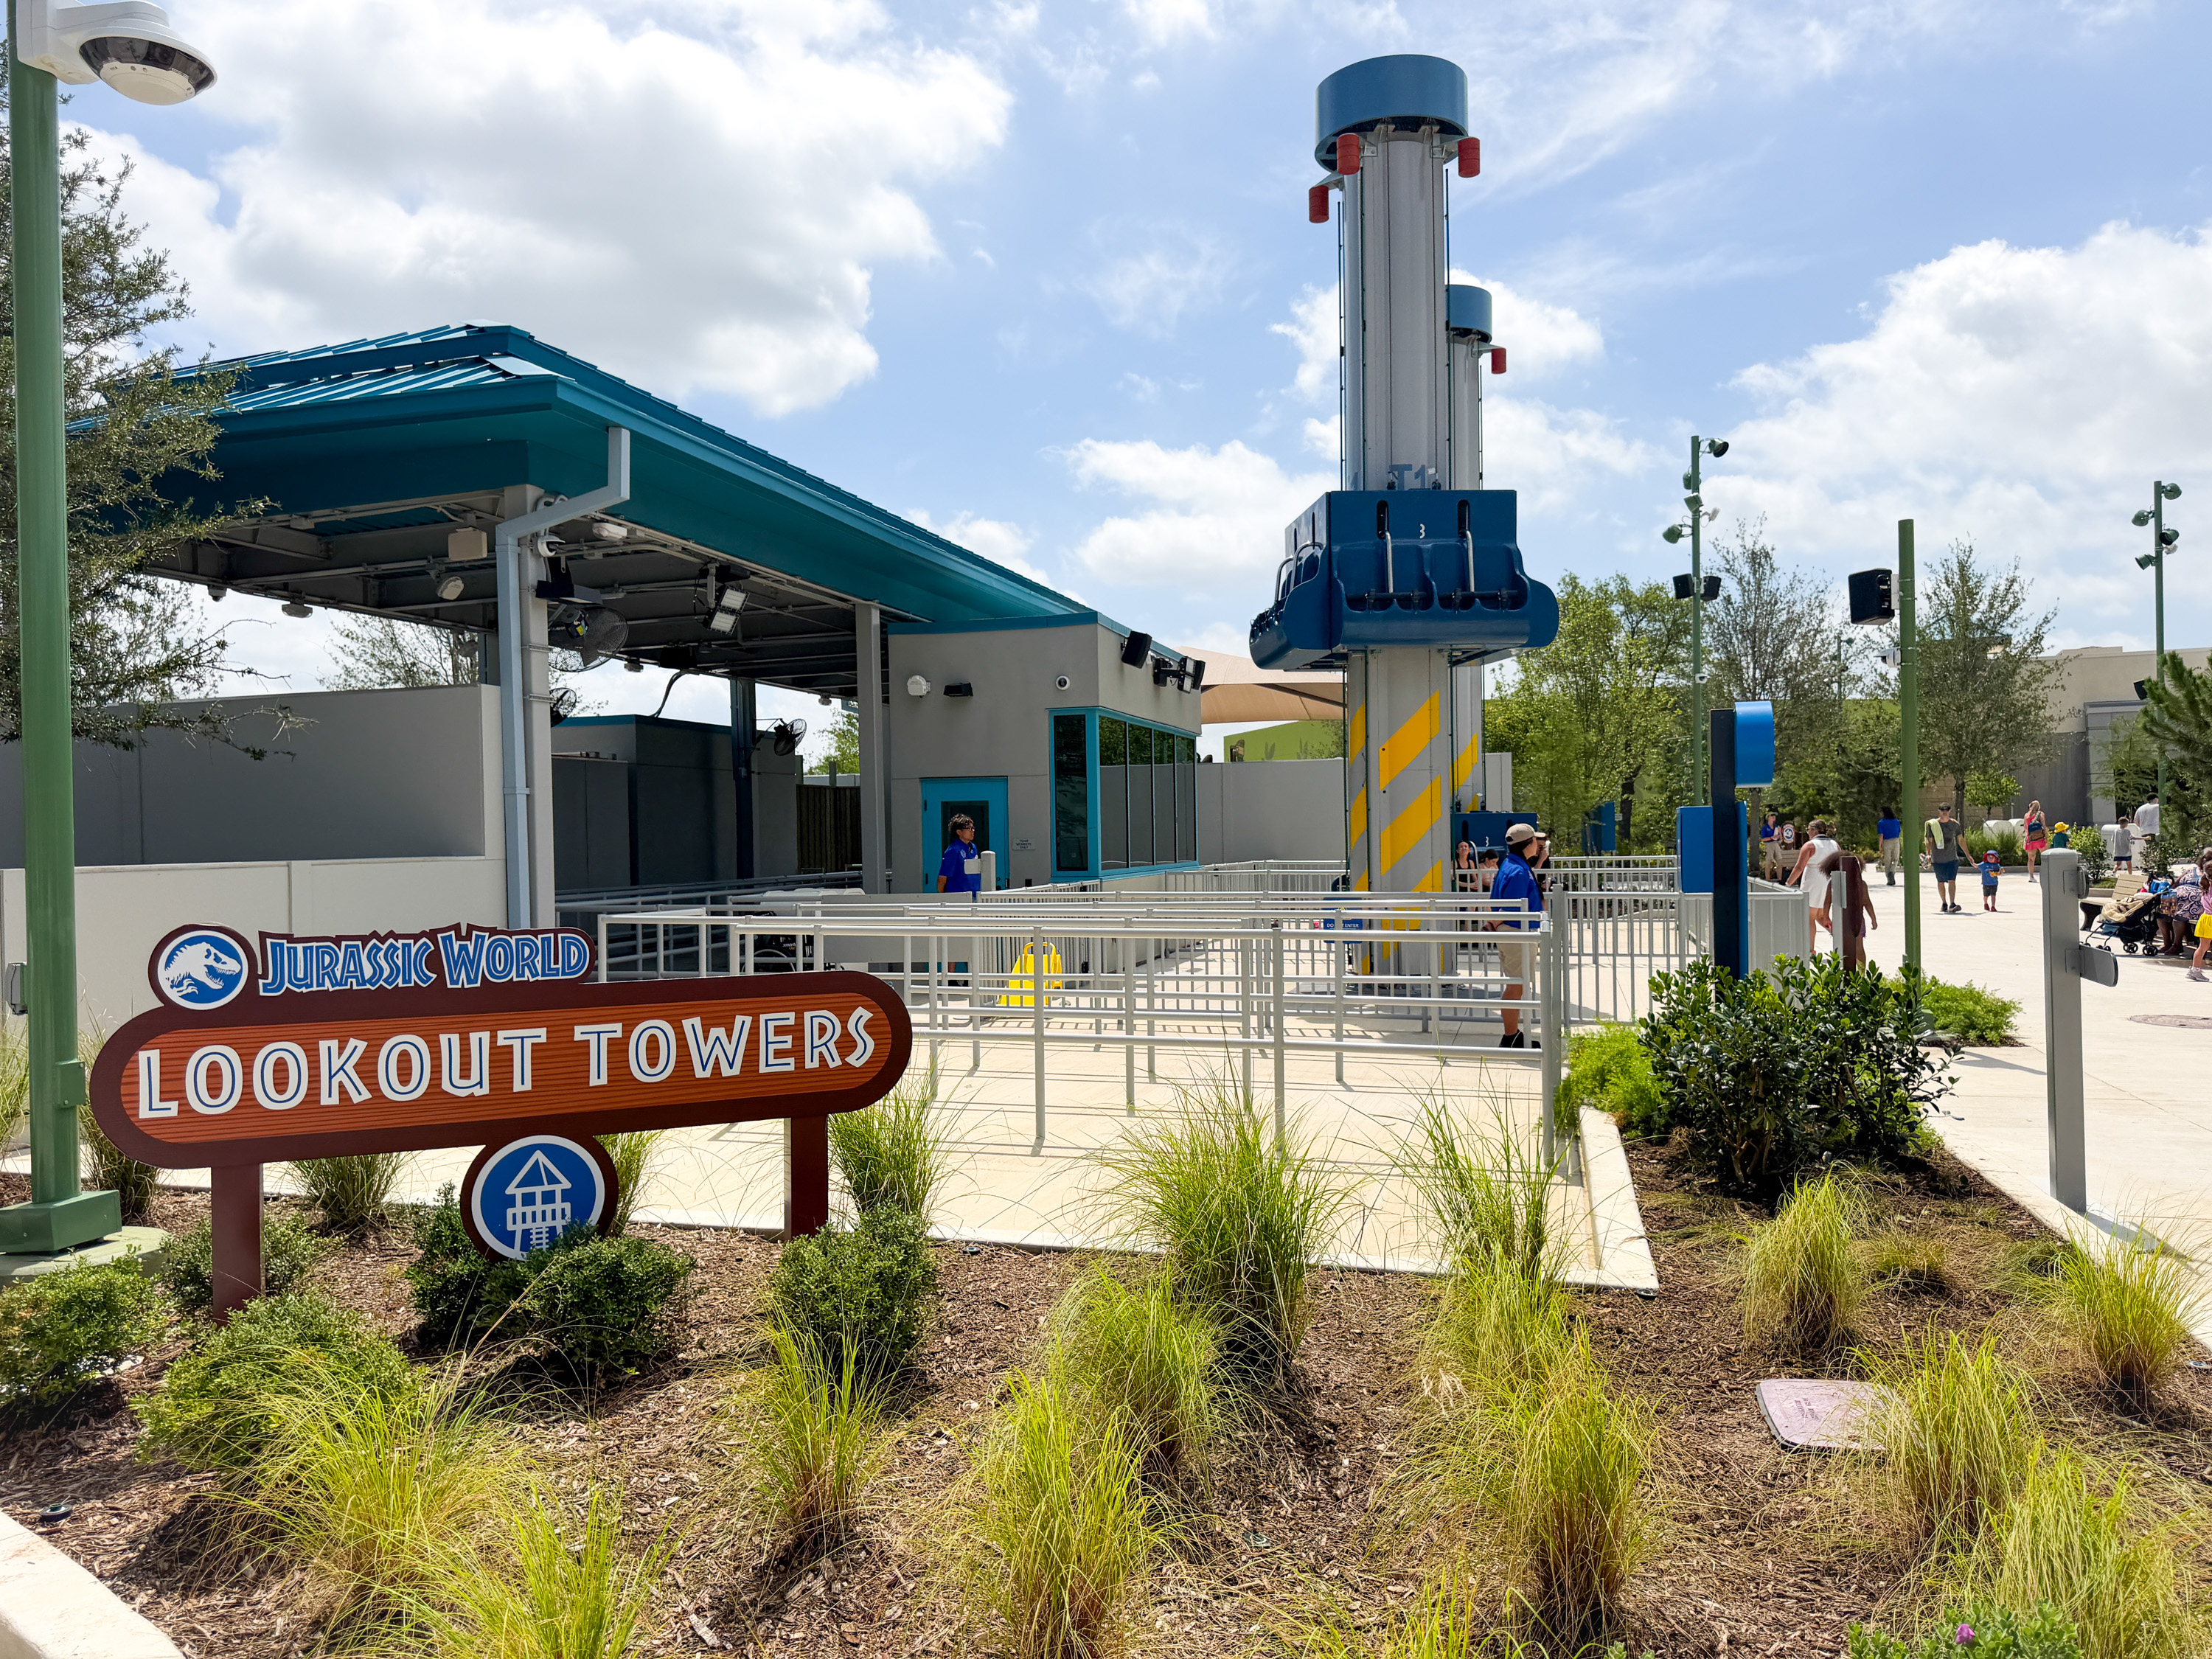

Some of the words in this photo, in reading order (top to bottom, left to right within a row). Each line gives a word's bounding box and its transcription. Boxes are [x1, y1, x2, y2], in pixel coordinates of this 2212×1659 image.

[1389, 464, 1426, 490] T1
[1419, 524, 1425, 539] 3
[1485, 835, 1489, 847] 3
[259, 937, 437, 995] JURASSIC
[437, 931, 590, 988] WORLD
[139, 1028, 547, 1119] LOOKOUT
[574, 1006, 874, 1087] TOWERS
